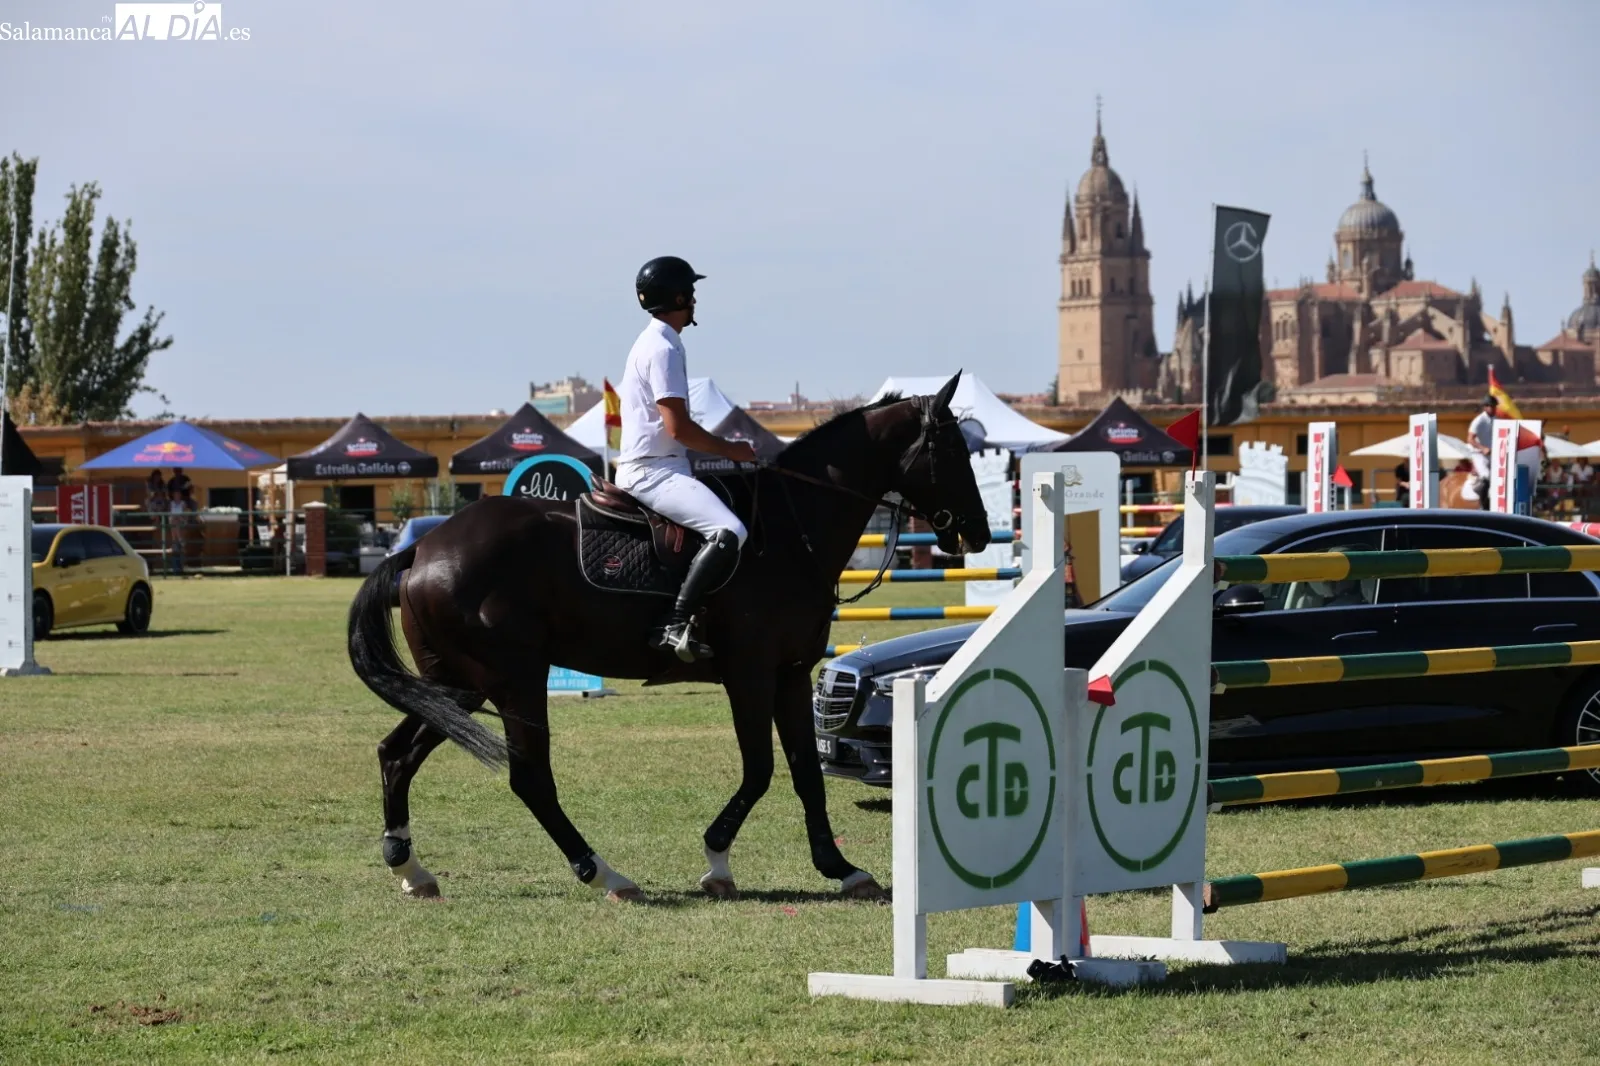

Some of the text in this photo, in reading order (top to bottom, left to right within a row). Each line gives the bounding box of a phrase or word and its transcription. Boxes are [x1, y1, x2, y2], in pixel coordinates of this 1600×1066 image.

[315, 462, 396, 476] Estrella Galicia
[71, 491, 84, 524] ETA
[1064, 489, 1105, 499] Grande
[956, 722, 1029, 819] CTD
[1113, 712, 1177, 805] CTD
